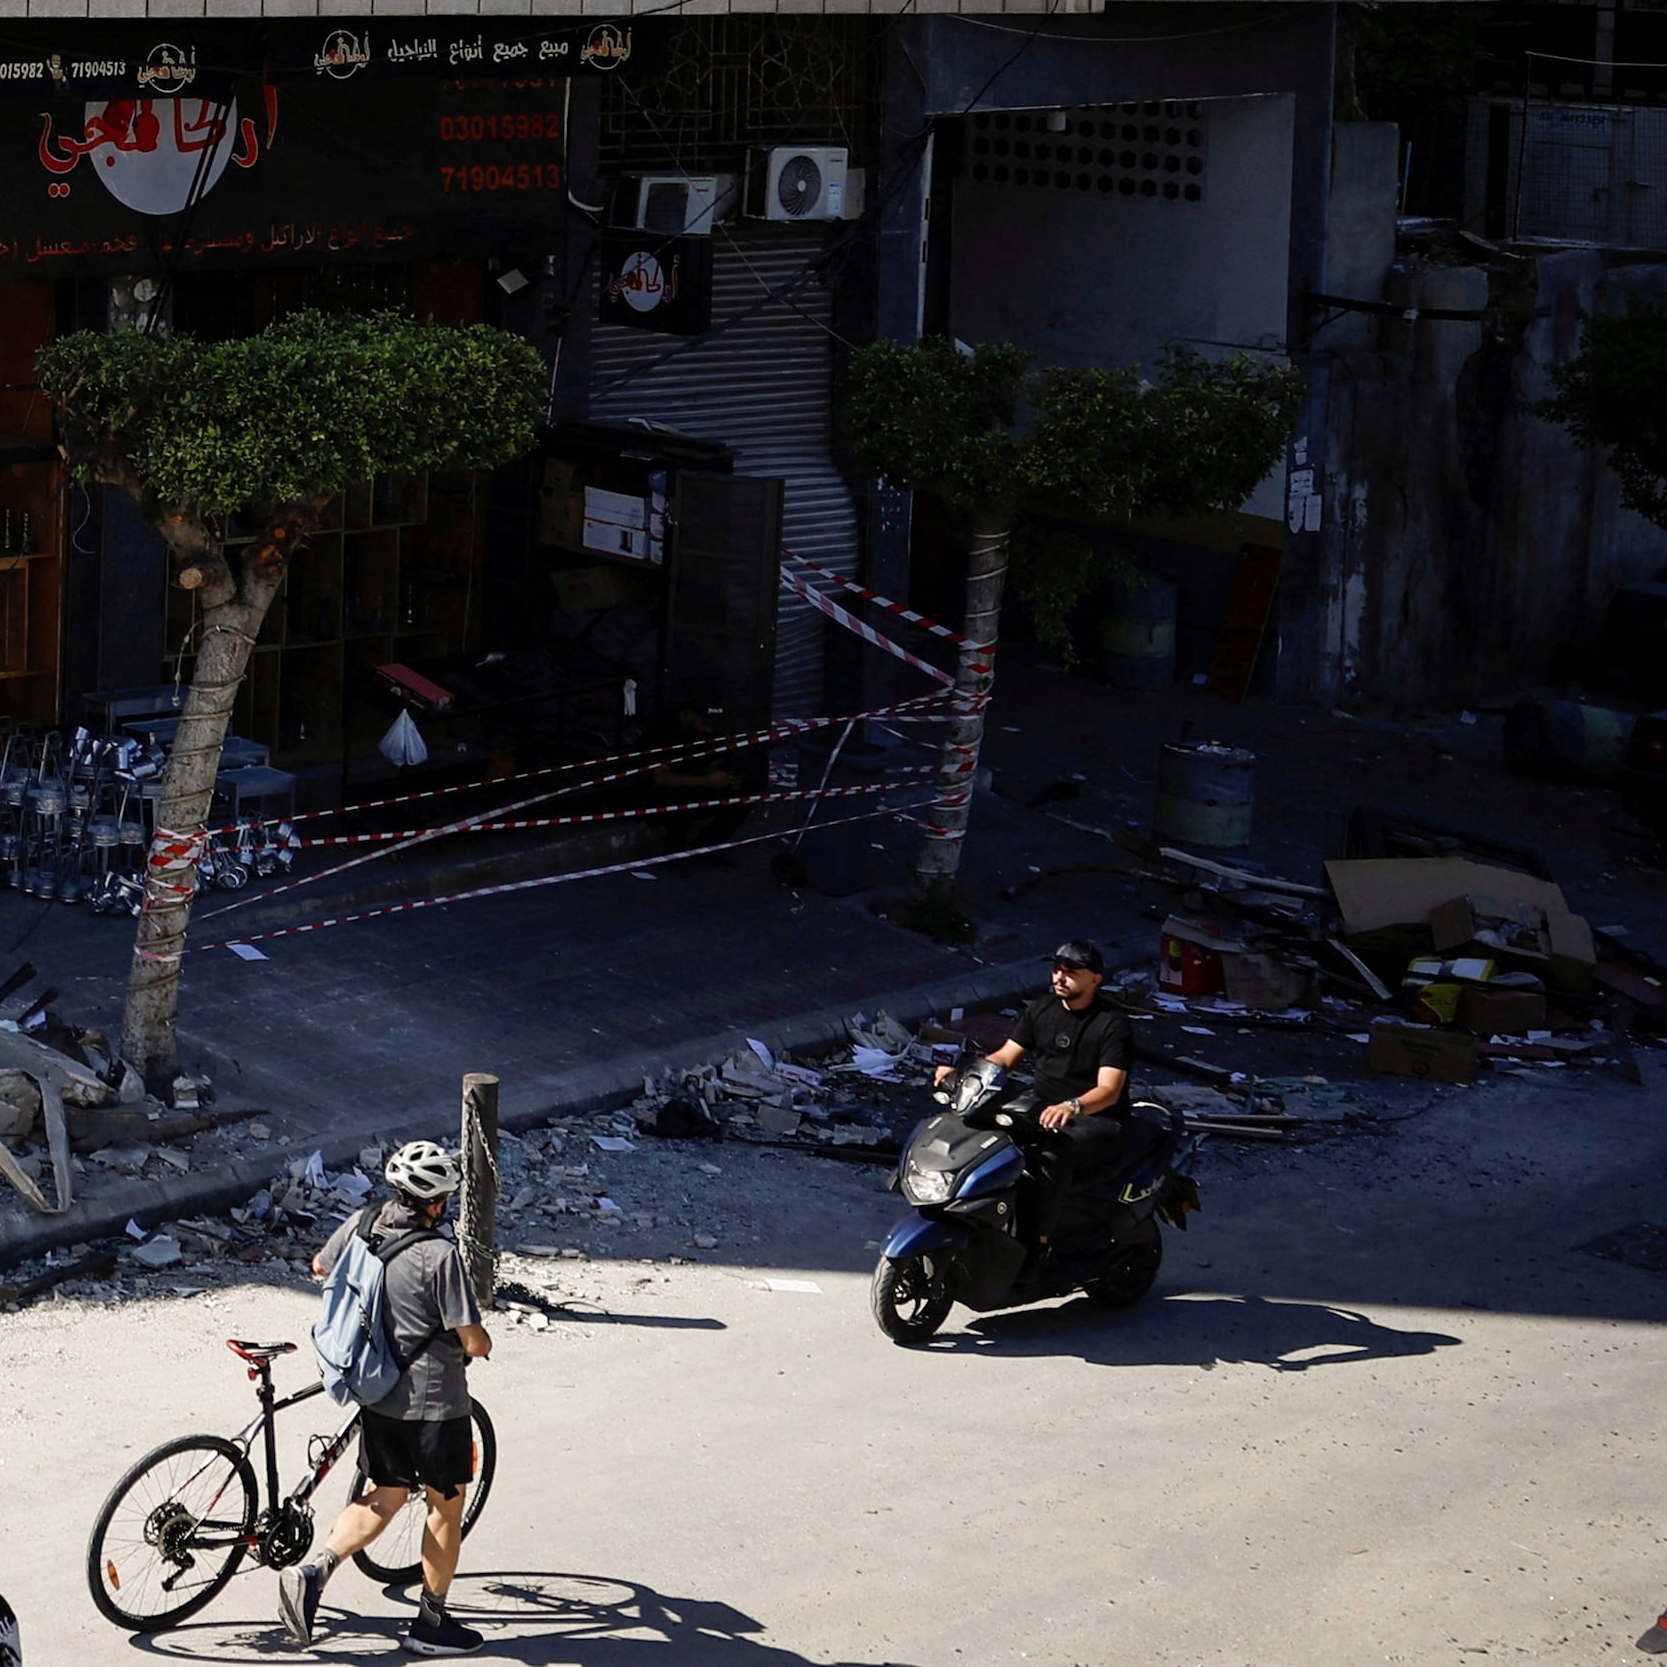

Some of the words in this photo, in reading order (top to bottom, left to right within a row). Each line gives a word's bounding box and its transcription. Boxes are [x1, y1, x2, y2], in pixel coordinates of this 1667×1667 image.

[70, 60, 127, 79] 71904513
[439, 113, 561, 142] 03015982
[439, 162, 563, 194] 71904513
